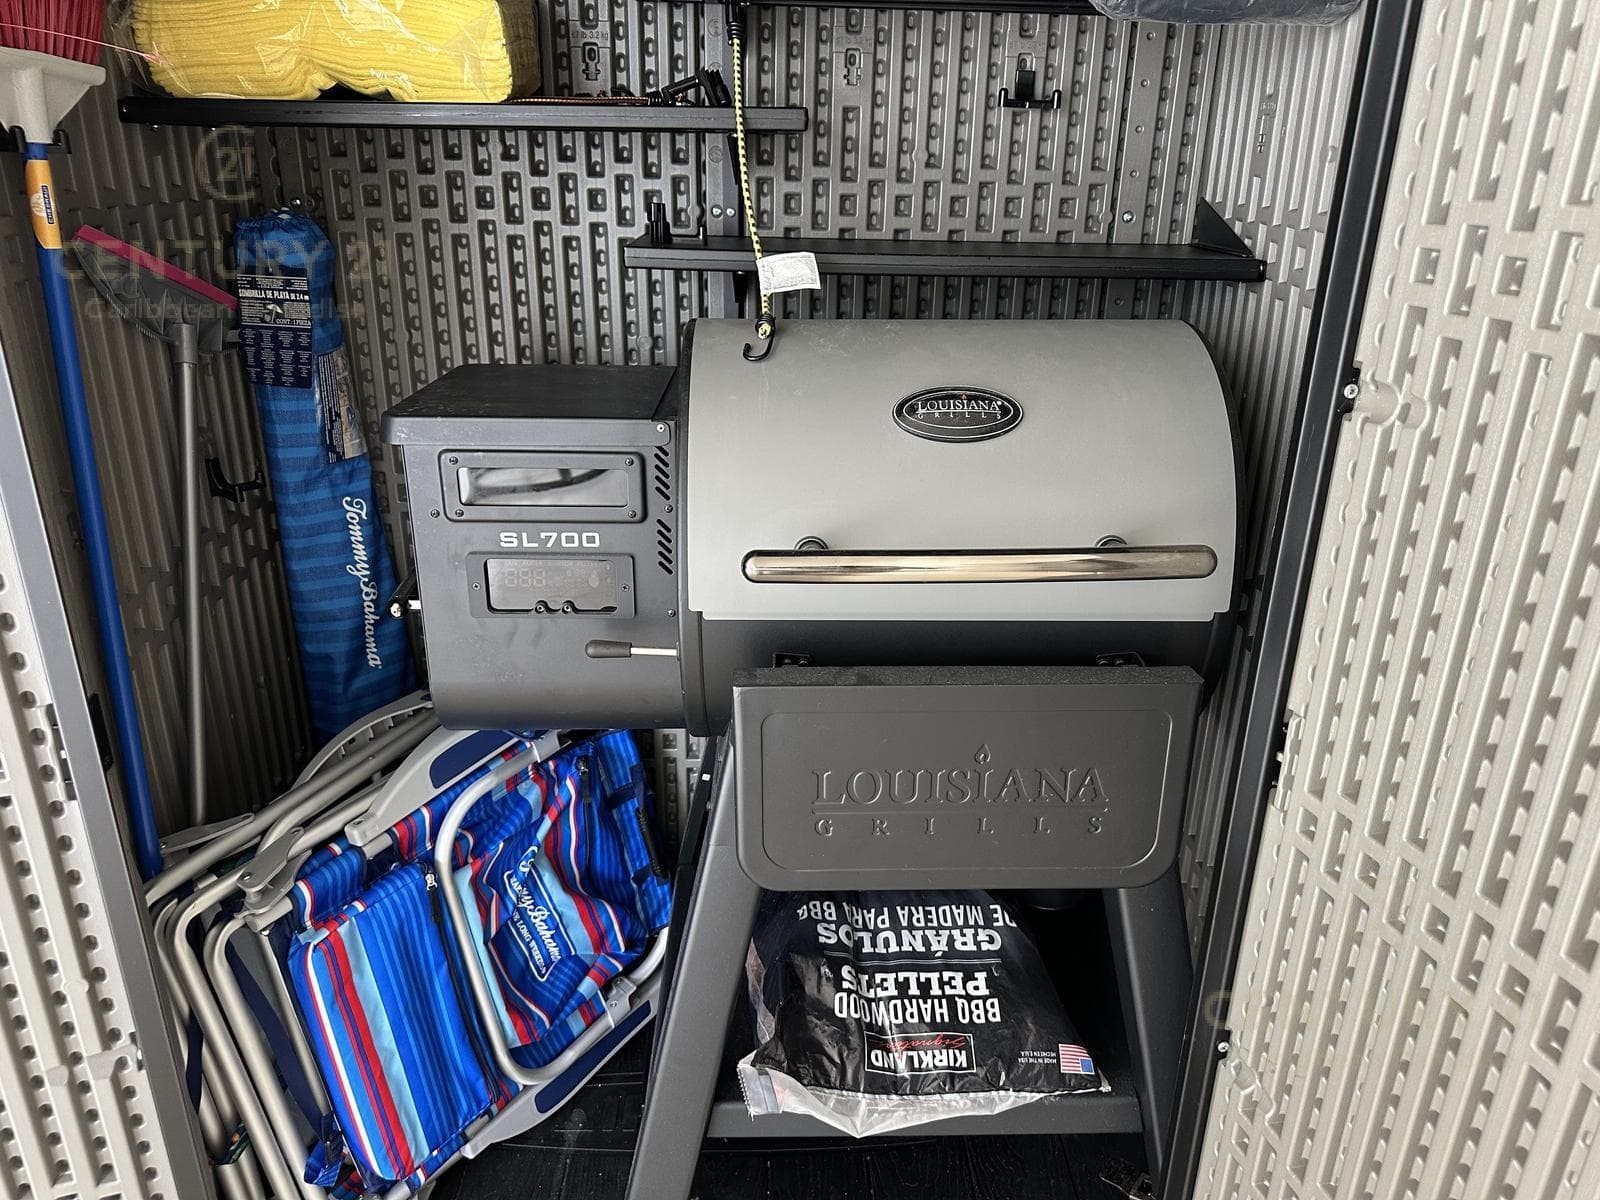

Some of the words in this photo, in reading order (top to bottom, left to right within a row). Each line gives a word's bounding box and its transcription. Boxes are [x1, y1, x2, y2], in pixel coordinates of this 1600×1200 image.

[266, 290, 273, 299] DE
[274, 291, 290, 300] PLAYA
[916, 411, 1002, 420] GRILLS
[917, 399, 1000, 412] LOUISIANA
[499, 531, 601, 549] SL700
[342, 496, 371, 582] Tommy
[359, 576, 381, 668] Bahama
[811, 766, 1109, 806] LOUISIANA
[813, 816, 1103, 837] GRILLS
[842, 901, 890, 930] PARA
[895, 904, 985, 928] MADERA
[516, 917, 532, 943] LONG
[816, 921, 1003, 958] GRÁNULOS
[841, 964, 991, 999] PELLETS
[833, 991, 950, 1028] HARDWOOD
[954, 995, 1002, 1025] BBQ
[869, 1048, 969, 1071] KIRKLAND
